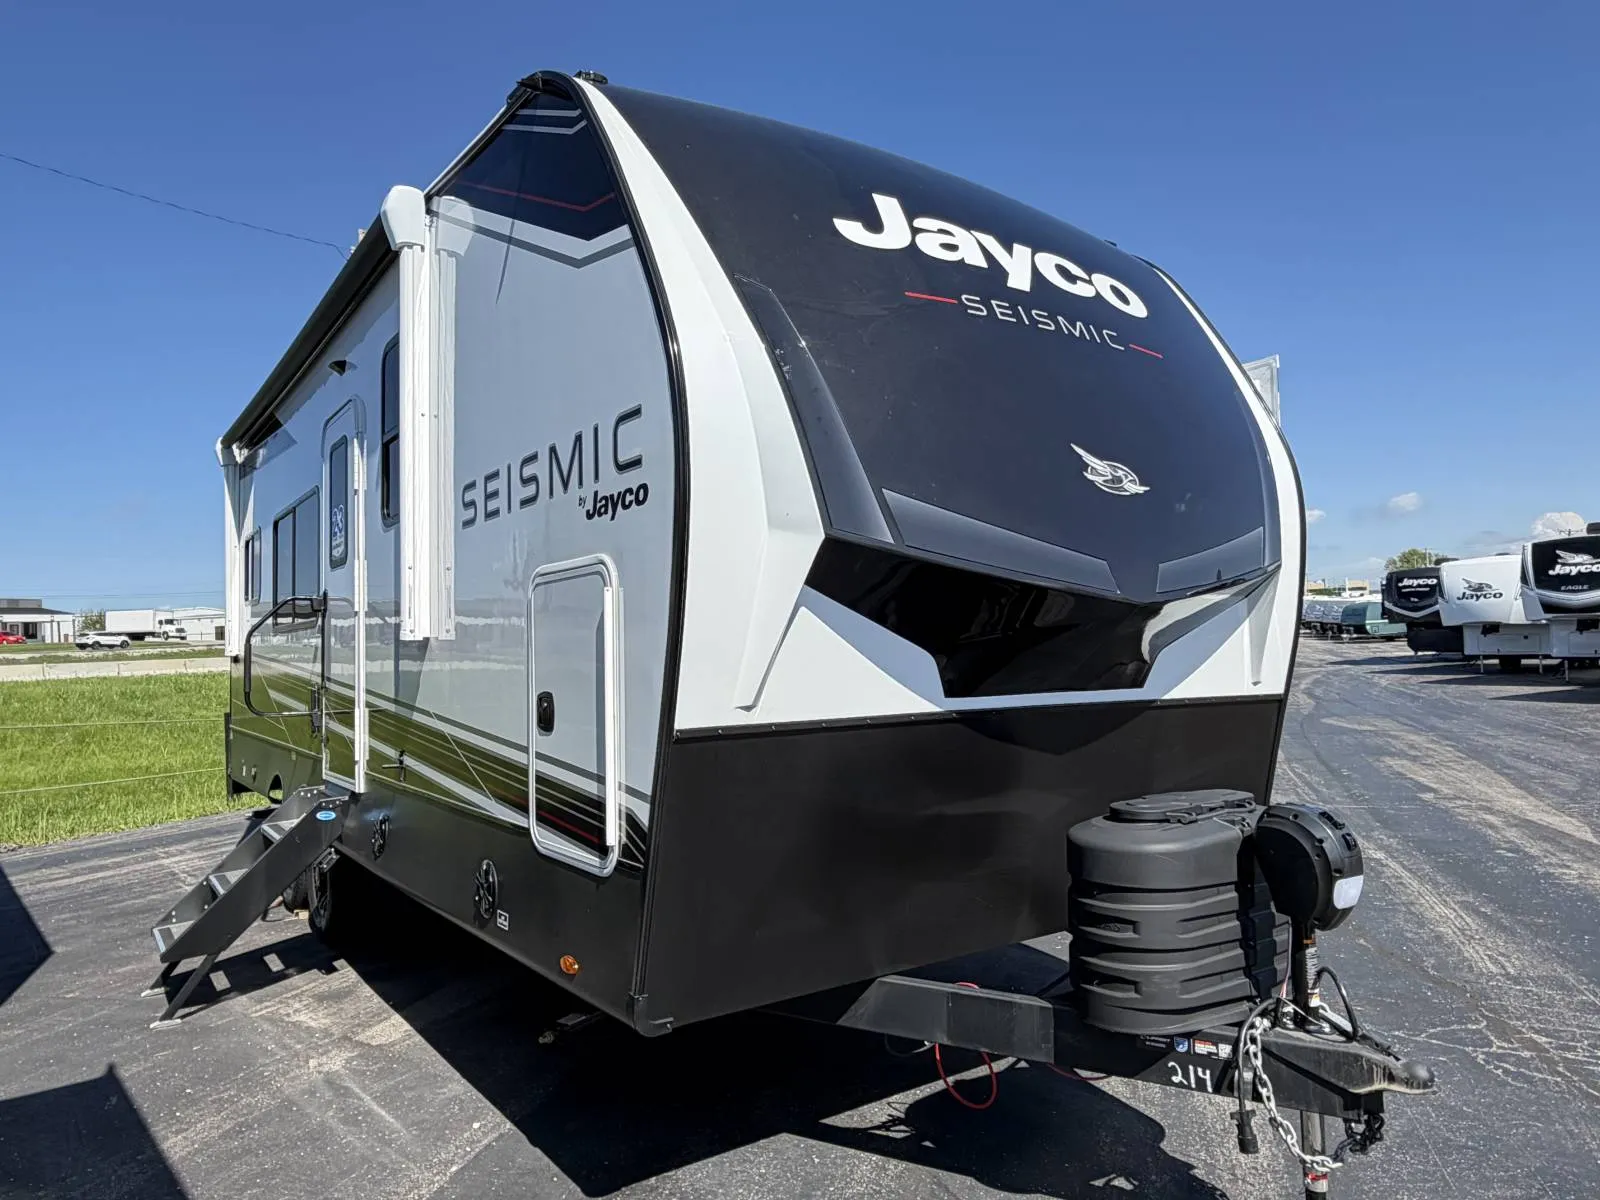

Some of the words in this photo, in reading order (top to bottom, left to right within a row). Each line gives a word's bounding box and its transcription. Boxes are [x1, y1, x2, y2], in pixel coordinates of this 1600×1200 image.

[832, 192, 1148, 319] Jayco
[960, 294, 1125, 351] SEISMIC
[461, 403, 643, 530] SEISMIC
[578, 495, 588, 509] by
[585, 482, 649, 521] Jayco
[1397, 577, 1438, 587] Jayco
[1547, 564, 1600, 576] Jayco
[1456, 591, 1504, 602] Jayco
[1167, 1061, 1213, 1093] 214
